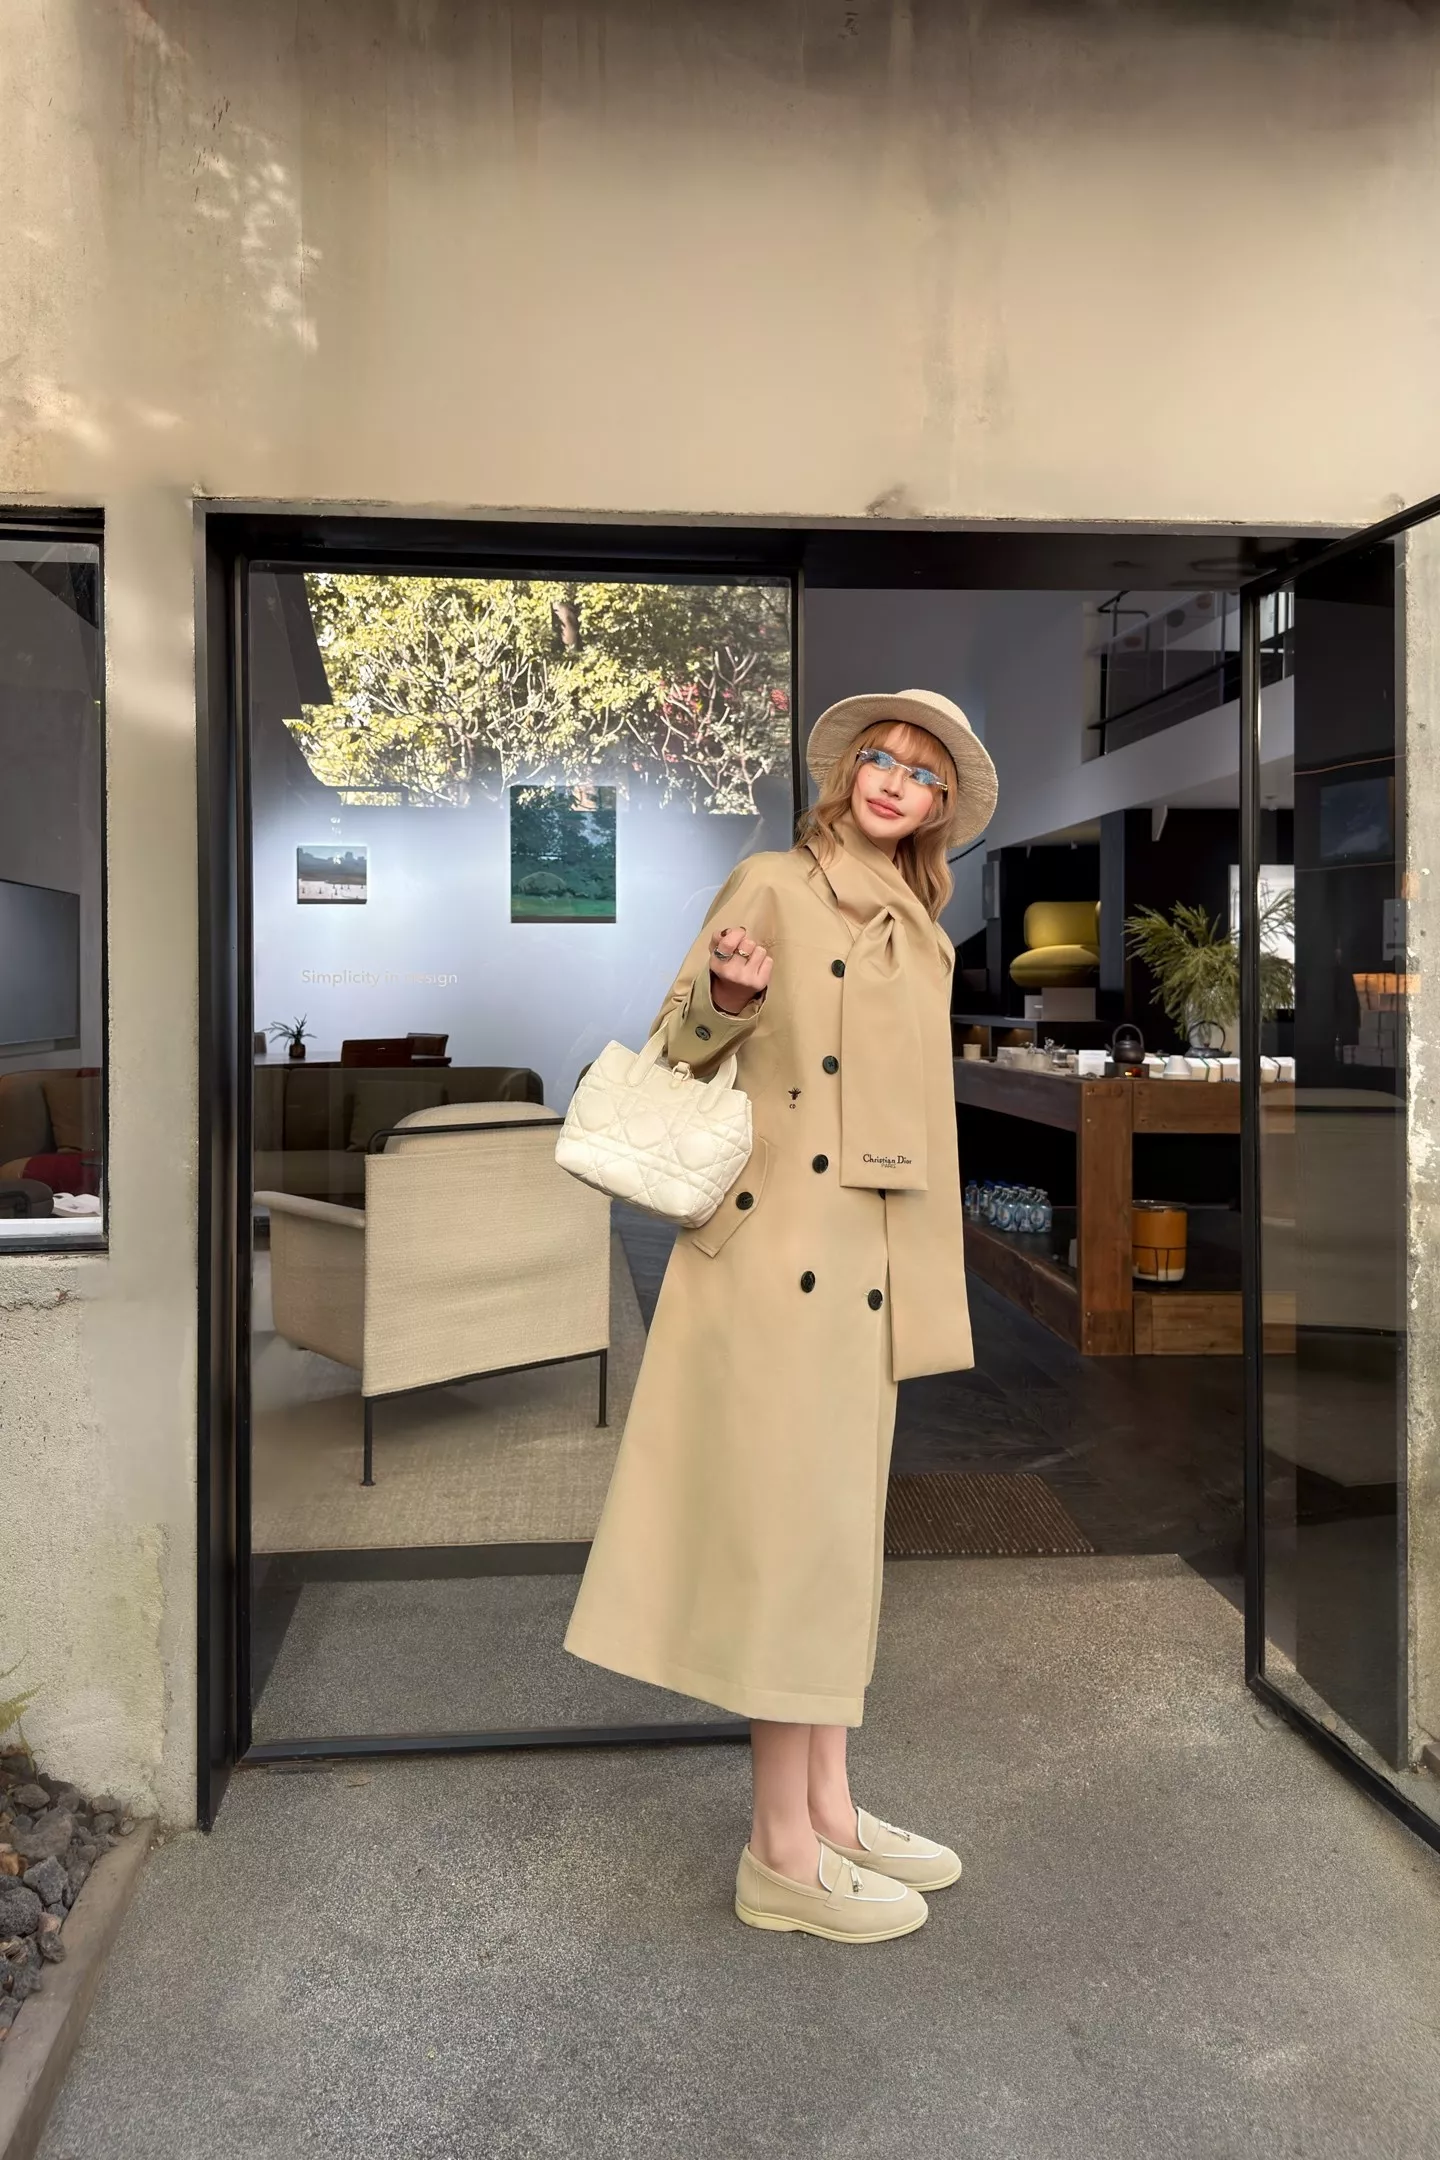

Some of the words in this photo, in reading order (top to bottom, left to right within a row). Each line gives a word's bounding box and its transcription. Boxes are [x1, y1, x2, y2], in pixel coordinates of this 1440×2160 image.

[302, 969, 380, 987] Simplicity
[385, 970, 399, 984] in
[862, 1153, 896, 1164] Christian
[897, 1155, 912, 1165] Dior
